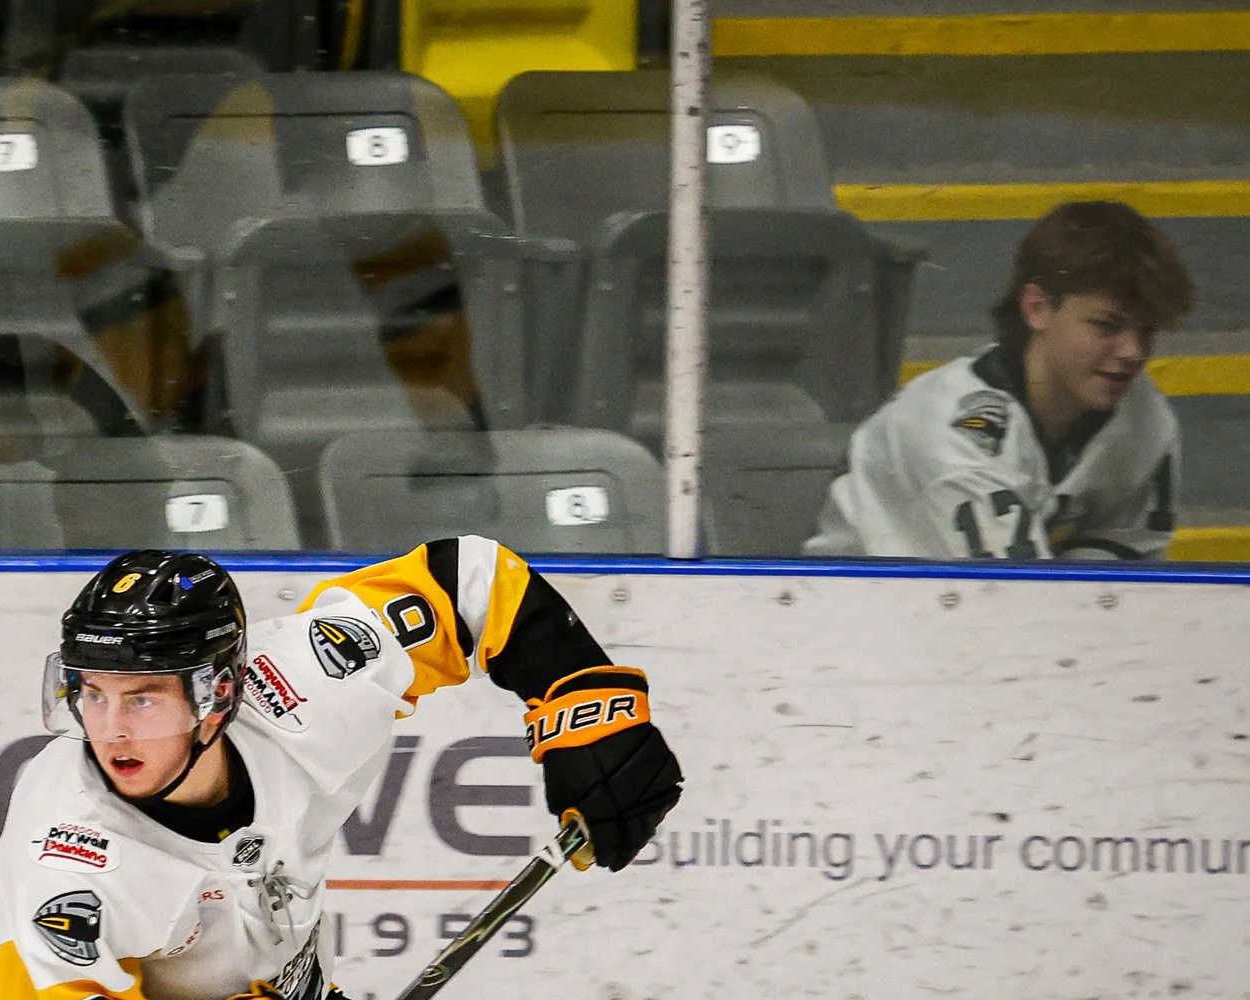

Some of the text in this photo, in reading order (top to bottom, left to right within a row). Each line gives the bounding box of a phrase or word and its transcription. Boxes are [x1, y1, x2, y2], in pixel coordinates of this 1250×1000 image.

[0, 141, 17, 164] 7
[370, 135, 388, 157] 8
[187, 502, 207, 525] 7
[568, 494, 589, 518] 8
[111, 572, 142, 594] 6
[75, 632, 124, 646] BAUER
[874, 834, 1003, 881] your
